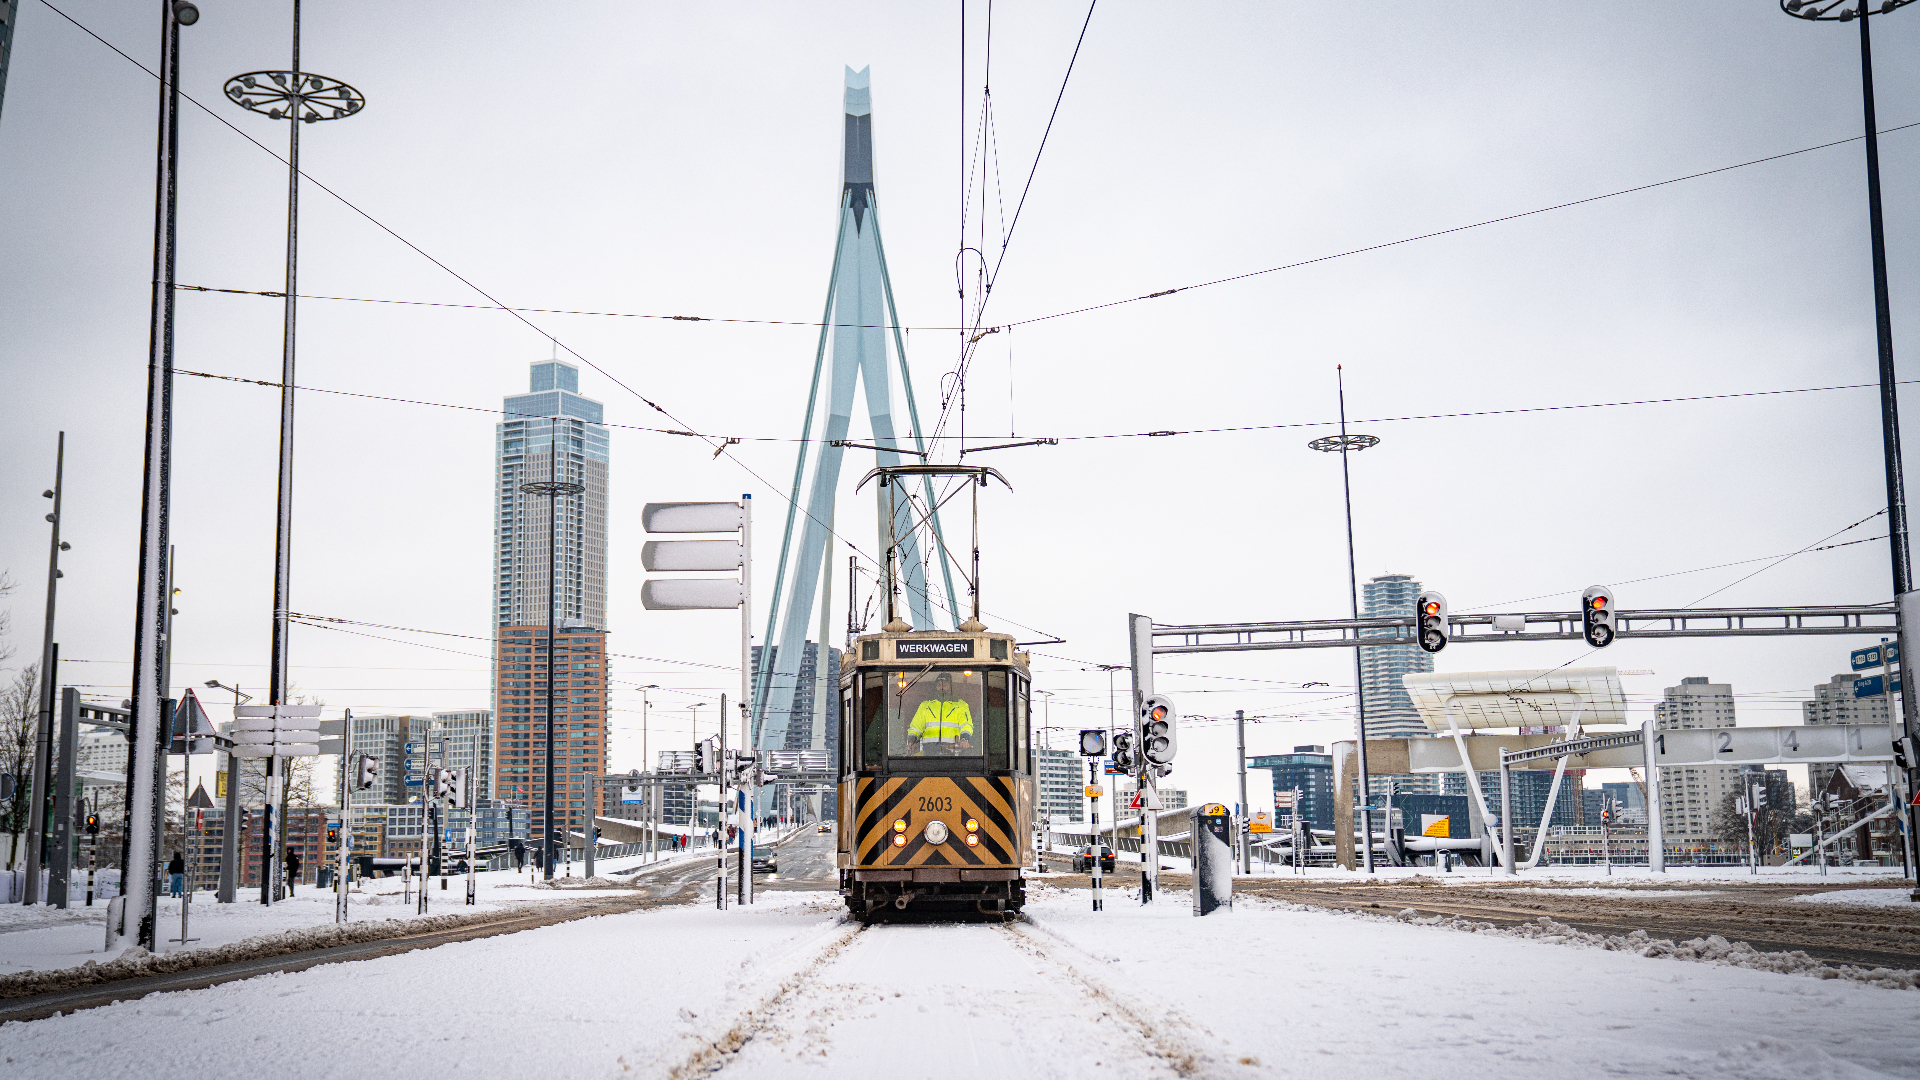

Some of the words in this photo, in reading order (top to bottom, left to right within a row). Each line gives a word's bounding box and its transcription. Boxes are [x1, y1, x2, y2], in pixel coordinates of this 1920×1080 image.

[899, 643, 968, 653] WERKWAGEN
[1654, 734, 1666, 755] 1
[1717, 731, 1734, 753] 2
[1783, 730, 1800, 751] 4
[1850, 728, 1863, 750] 1
[918, 796, 952, 812] 2603
